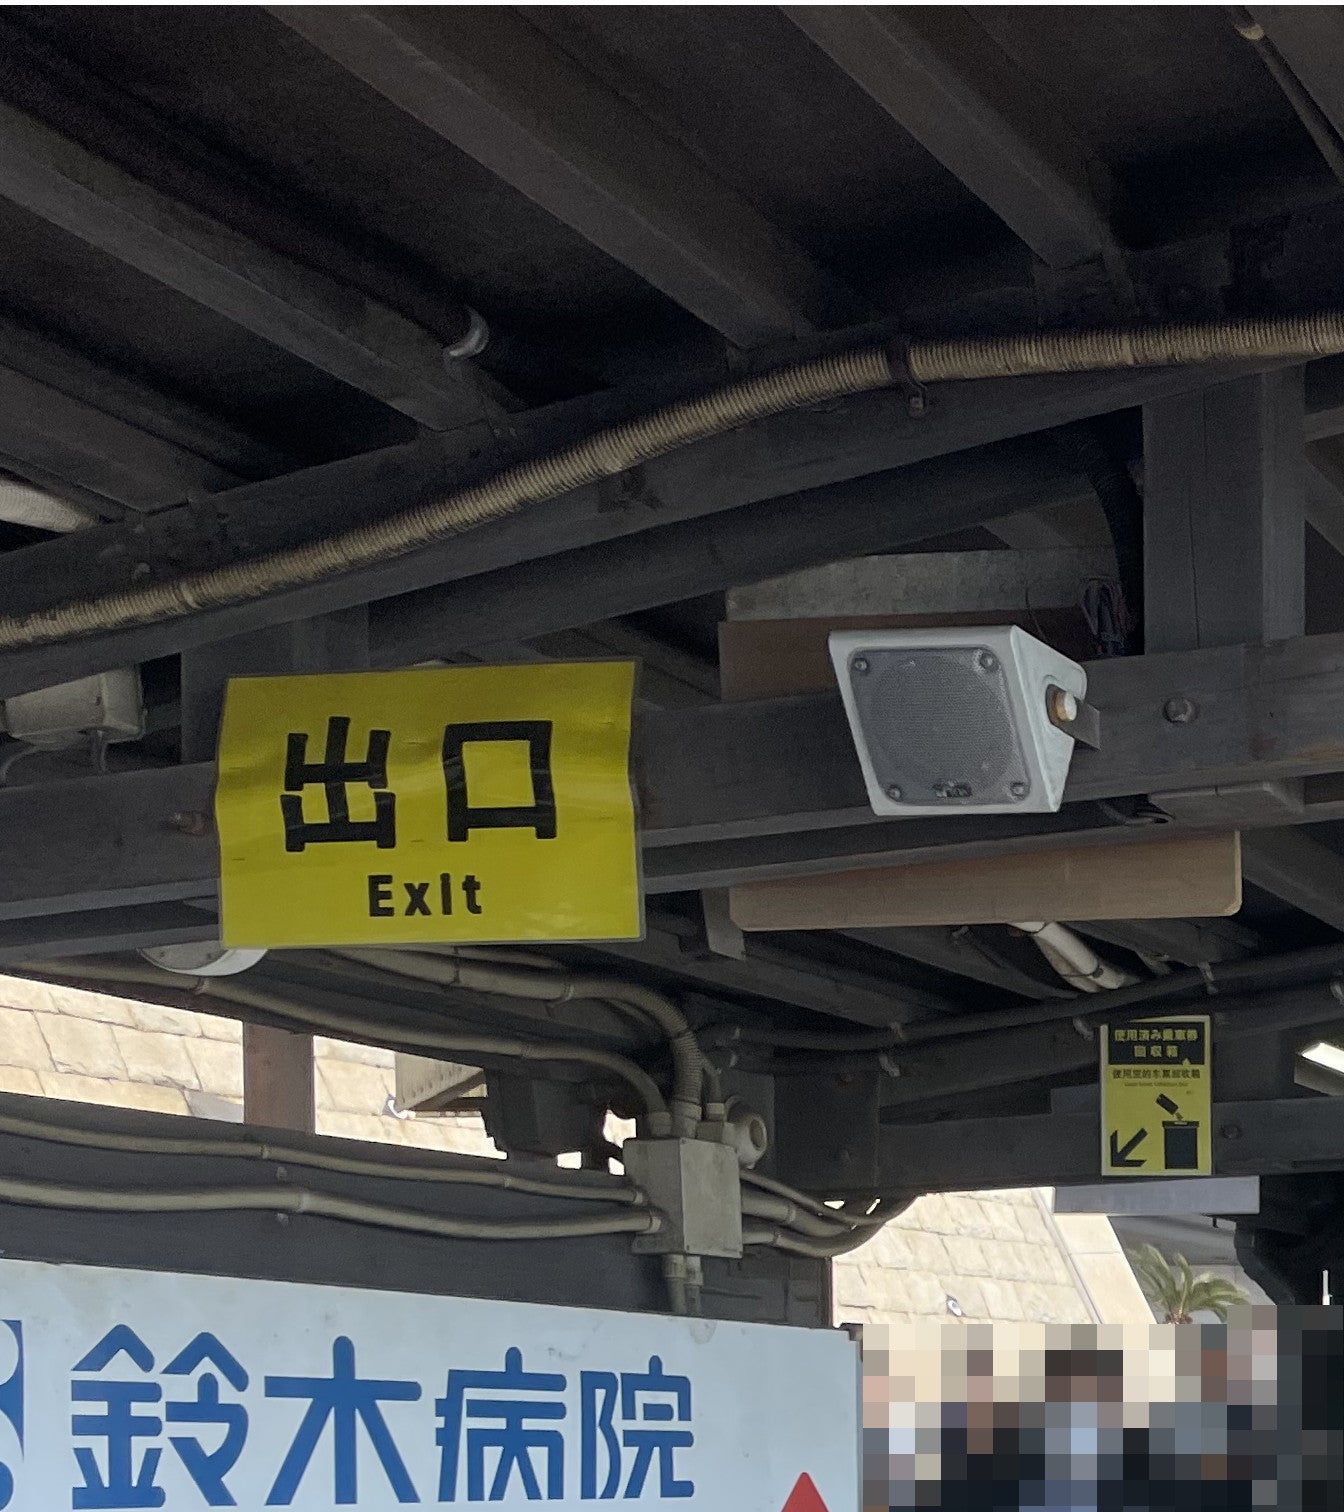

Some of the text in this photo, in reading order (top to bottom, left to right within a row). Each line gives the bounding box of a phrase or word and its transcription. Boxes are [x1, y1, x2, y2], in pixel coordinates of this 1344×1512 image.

[281, 716, 558, 853] 出口
[71, 1323, 695, 1510] 鈴木病院
